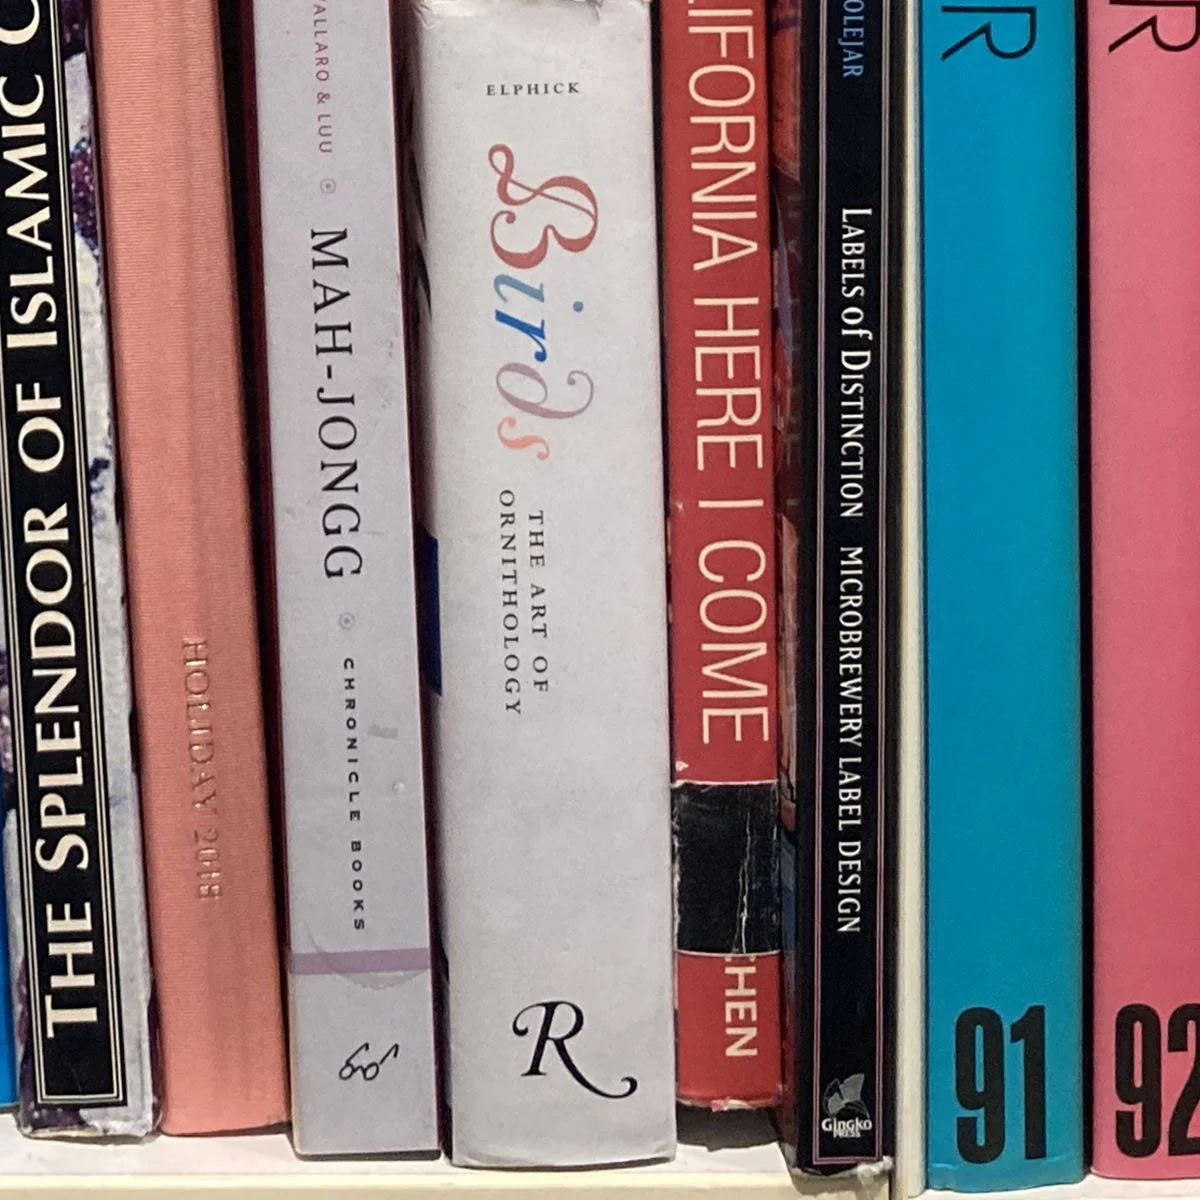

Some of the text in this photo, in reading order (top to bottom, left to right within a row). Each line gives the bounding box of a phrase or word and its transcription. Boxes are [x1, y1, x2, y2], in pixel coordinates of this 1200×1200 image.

[316, 91, 331, 105] &
[318, 112, 334, 155] LUU
[487, 81, 581, 97] ELPHICK
[487, 143, 599, 462] Birds
[841, 306, 873, 340] of
[15, 381, 66, 474] OF
[310, 228, 363, 580] MAH-JONGG
[693, 295, 764, 472] HERE
[698, 497, 765, 509] I
[499, 488, 522, 716] ORNITHOLOGY
[527, 509, 549, 693] THE ART OF
[698, 537, 770, 745] COME
[837, 546, 865, 747] MICROBREWERY
[23, 502, 90, 872] SPLENDOR
[343, 657, 365, 931] CHRONICLE BOOKS
[836, 757, 863, 831] LABEL
[837, 840, 863, 934] DESIGN
[45, 902, 98, 1040] THE
[511, 999, 638, 1100] R
[954, 1004, 1048, 1165] 91
